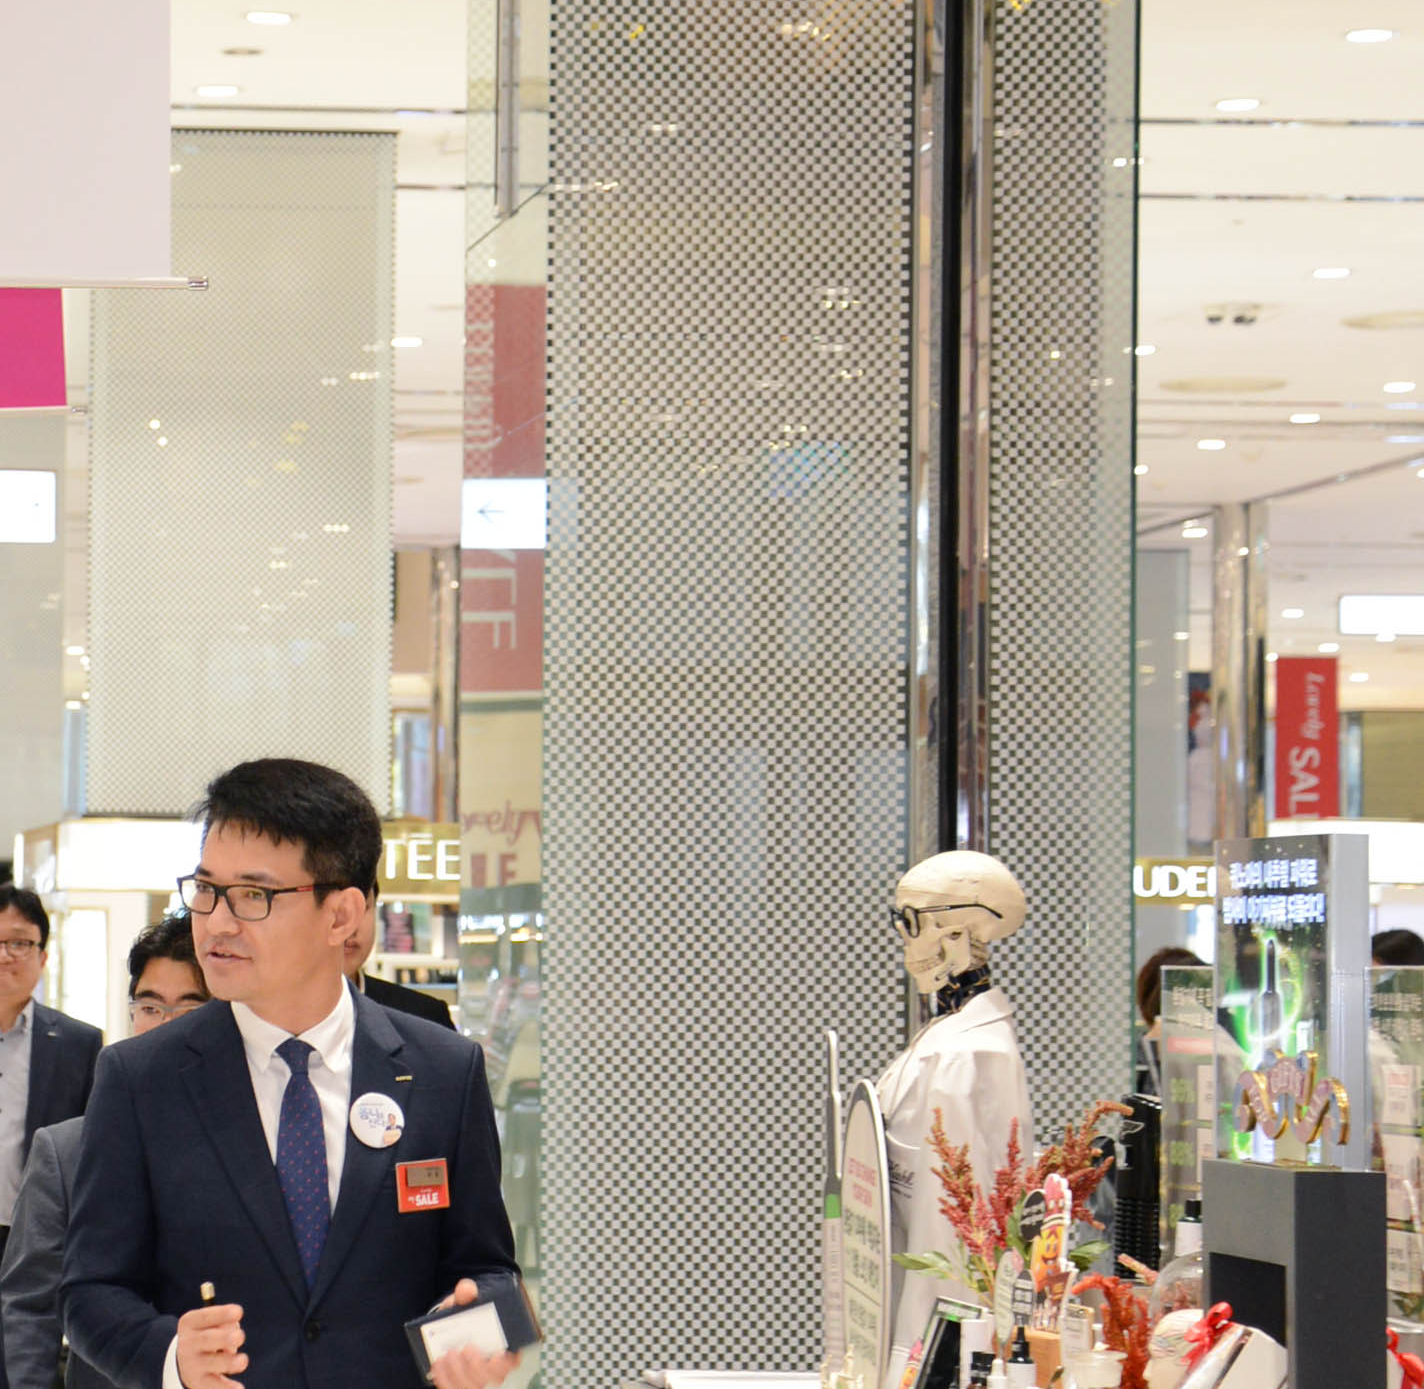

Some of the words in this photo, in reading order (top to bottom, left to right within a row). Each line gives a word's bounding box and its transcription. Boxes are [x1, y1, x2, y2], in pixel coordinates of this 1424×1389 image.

[1288, 746, 1321, 819] SAL
[1132, 864, 1217, 898] UDE
[415, 1192, 439, 1207] SALE
